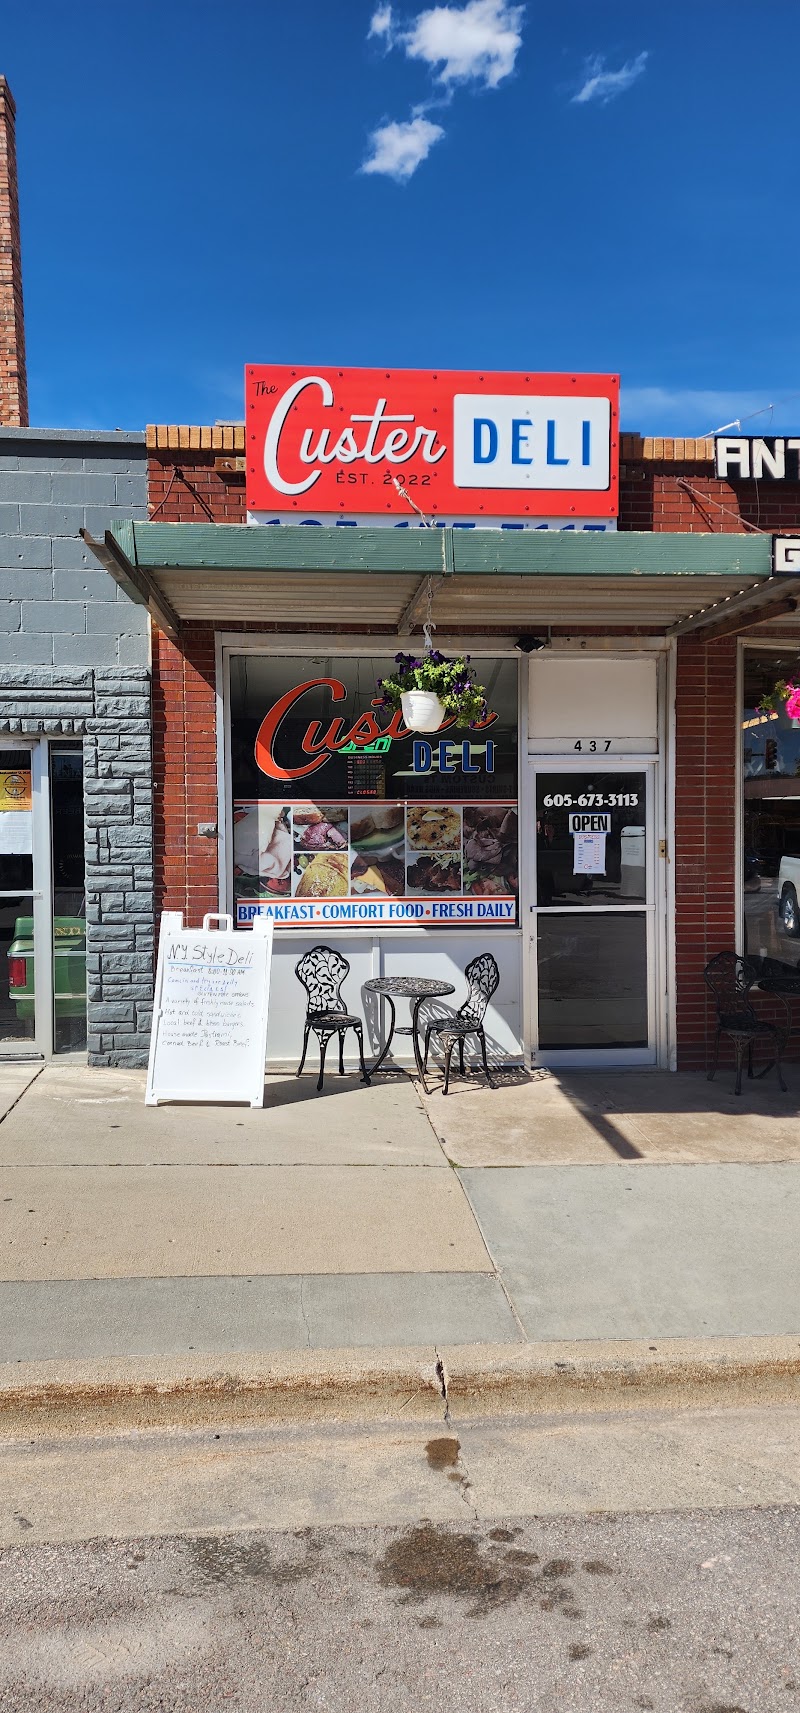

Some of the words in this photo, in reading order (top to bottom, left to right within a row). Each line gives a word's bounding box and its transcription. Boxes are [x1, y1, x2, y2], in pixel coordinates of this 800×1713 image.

[253, 381, 278, 396] The
[264, 376, 447, 495] Custer
[473, 418, 591, 466] DELI
[336, 473, 374, 484] EST.
[383, 473, 431, 485] 2022
[413, 740, 495, 774] DELI
[543, 793, 639, 807] 605-673-3113
[572, 815, 608, 831] OPEN
[238, 905, 316, 920] BREAKFAST
[322, 903, 385, 918] COMFORT
[389, 903, 424, 918] FOOD
[432, 903, 473, 917] FRESH
[478, 902, 514, 917] DAILY
[192, 945, 225, 964] Style
[226, 947, 254, 966] Deli
